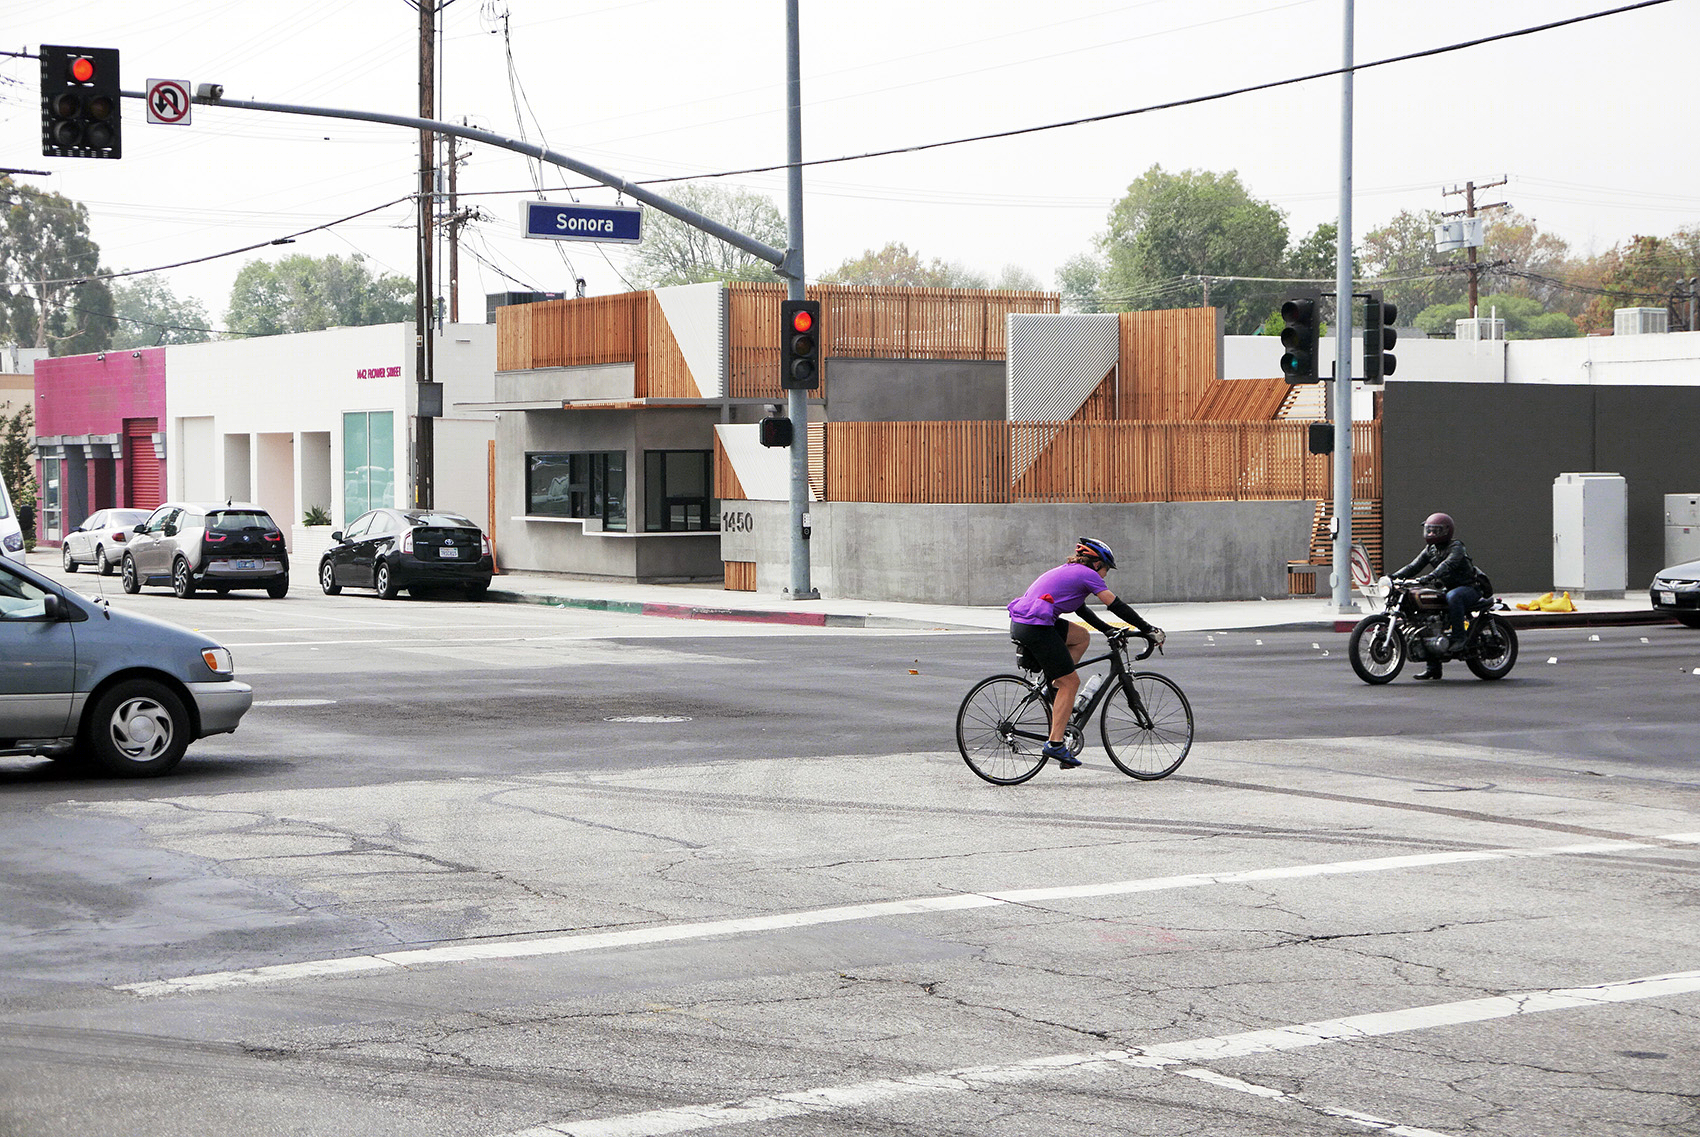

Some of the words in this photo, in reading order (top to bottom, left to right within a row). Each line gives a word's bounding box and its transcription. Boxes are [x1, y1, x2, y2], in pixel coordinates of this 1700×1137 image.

[556, 213, 613, 232] Sonora
[386, 366, 401, 378] STREET
[722, 511, 753, 533] 1450
